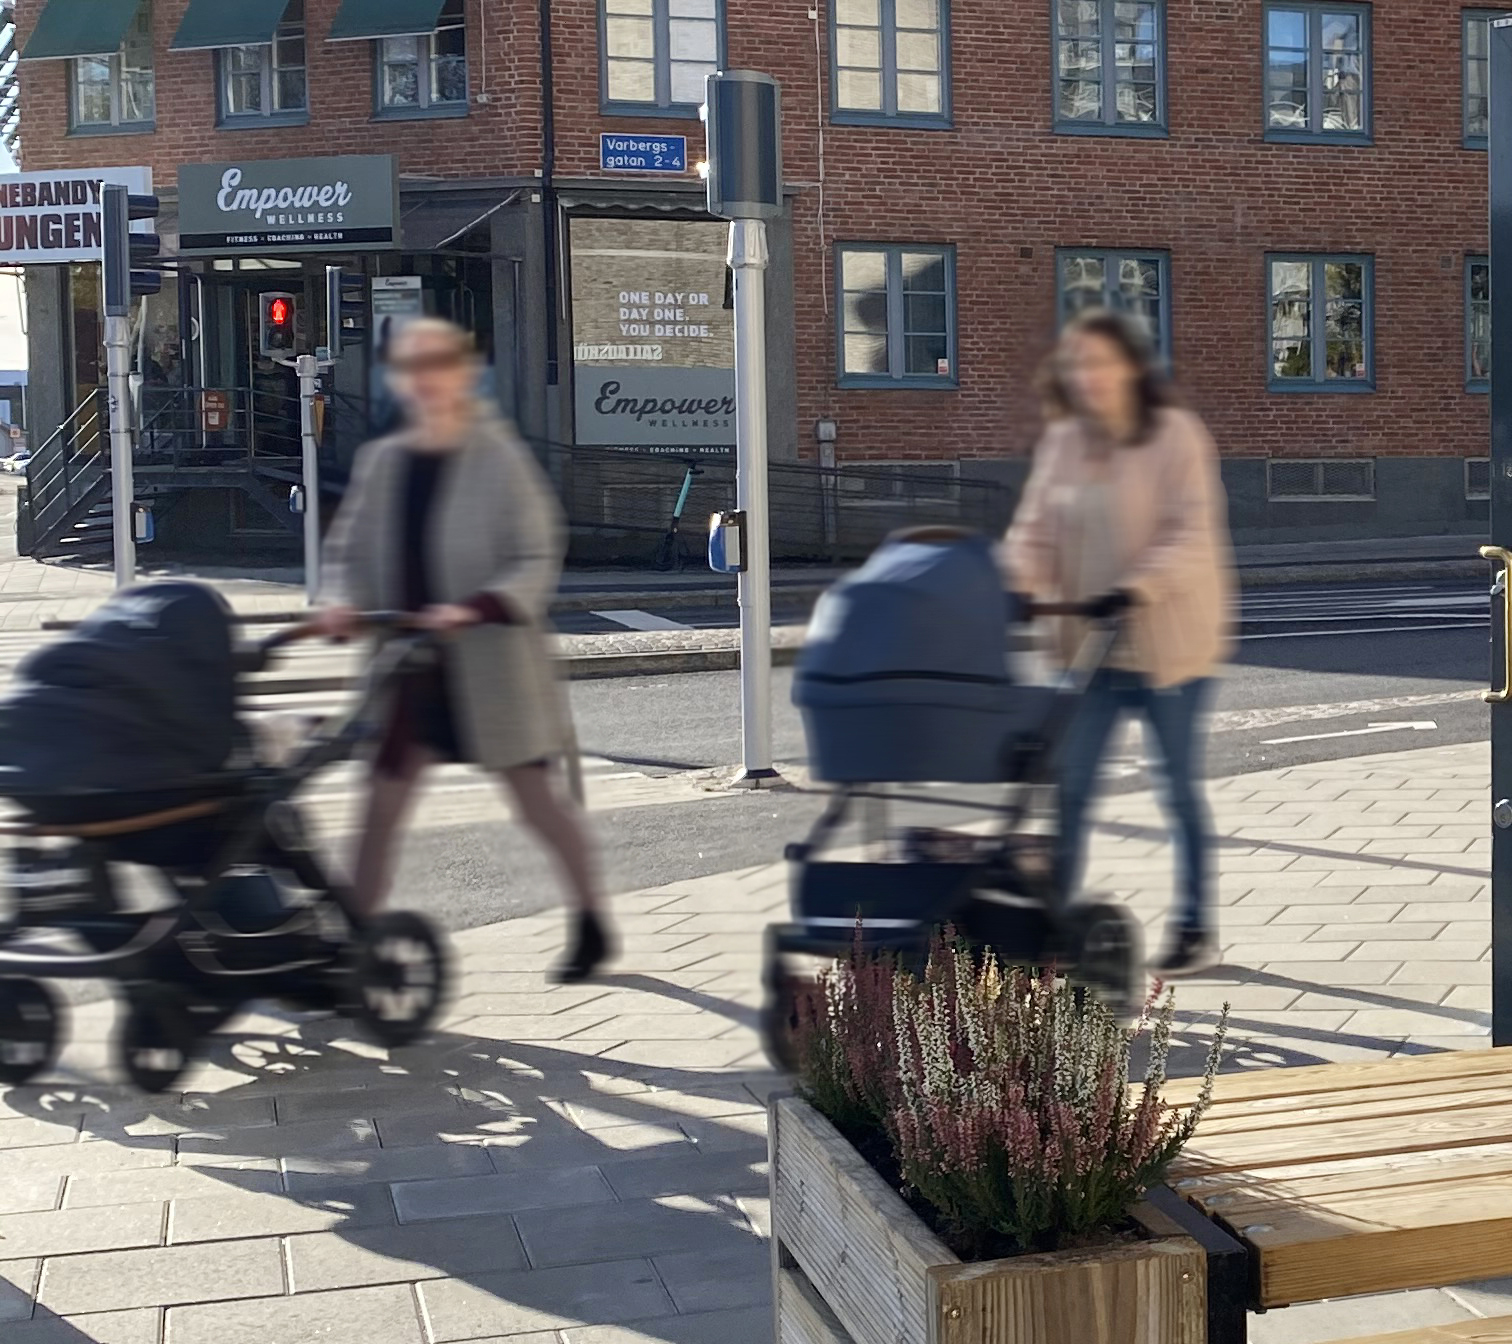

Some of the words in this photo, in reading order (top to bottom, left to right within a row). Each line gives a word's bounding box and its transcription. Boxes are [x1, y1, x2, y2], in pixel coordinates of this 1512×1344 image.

[606, 138, 676, 154] Varbergs-
[606, 155, 646, 168] gatan
[653, 155, 681, 168] 2-4
[216, 167, 352, 219] Empower
[266, 212, 344, 225] WELLNESS
[619, 291, 650, 304] ONE
[654, 292, 684, 305] DAY
[689, 293, 709, 305] OR
[619, 308, 649, 321] DAY
[654, 308, 689, 321] ONE.
[619, 324, 650, 336] YOU
[654, 324, 714, 337] DECIDE.
[594, 380, 736, 422] Empower
[649, 419, 730, 427] WELLNESS
